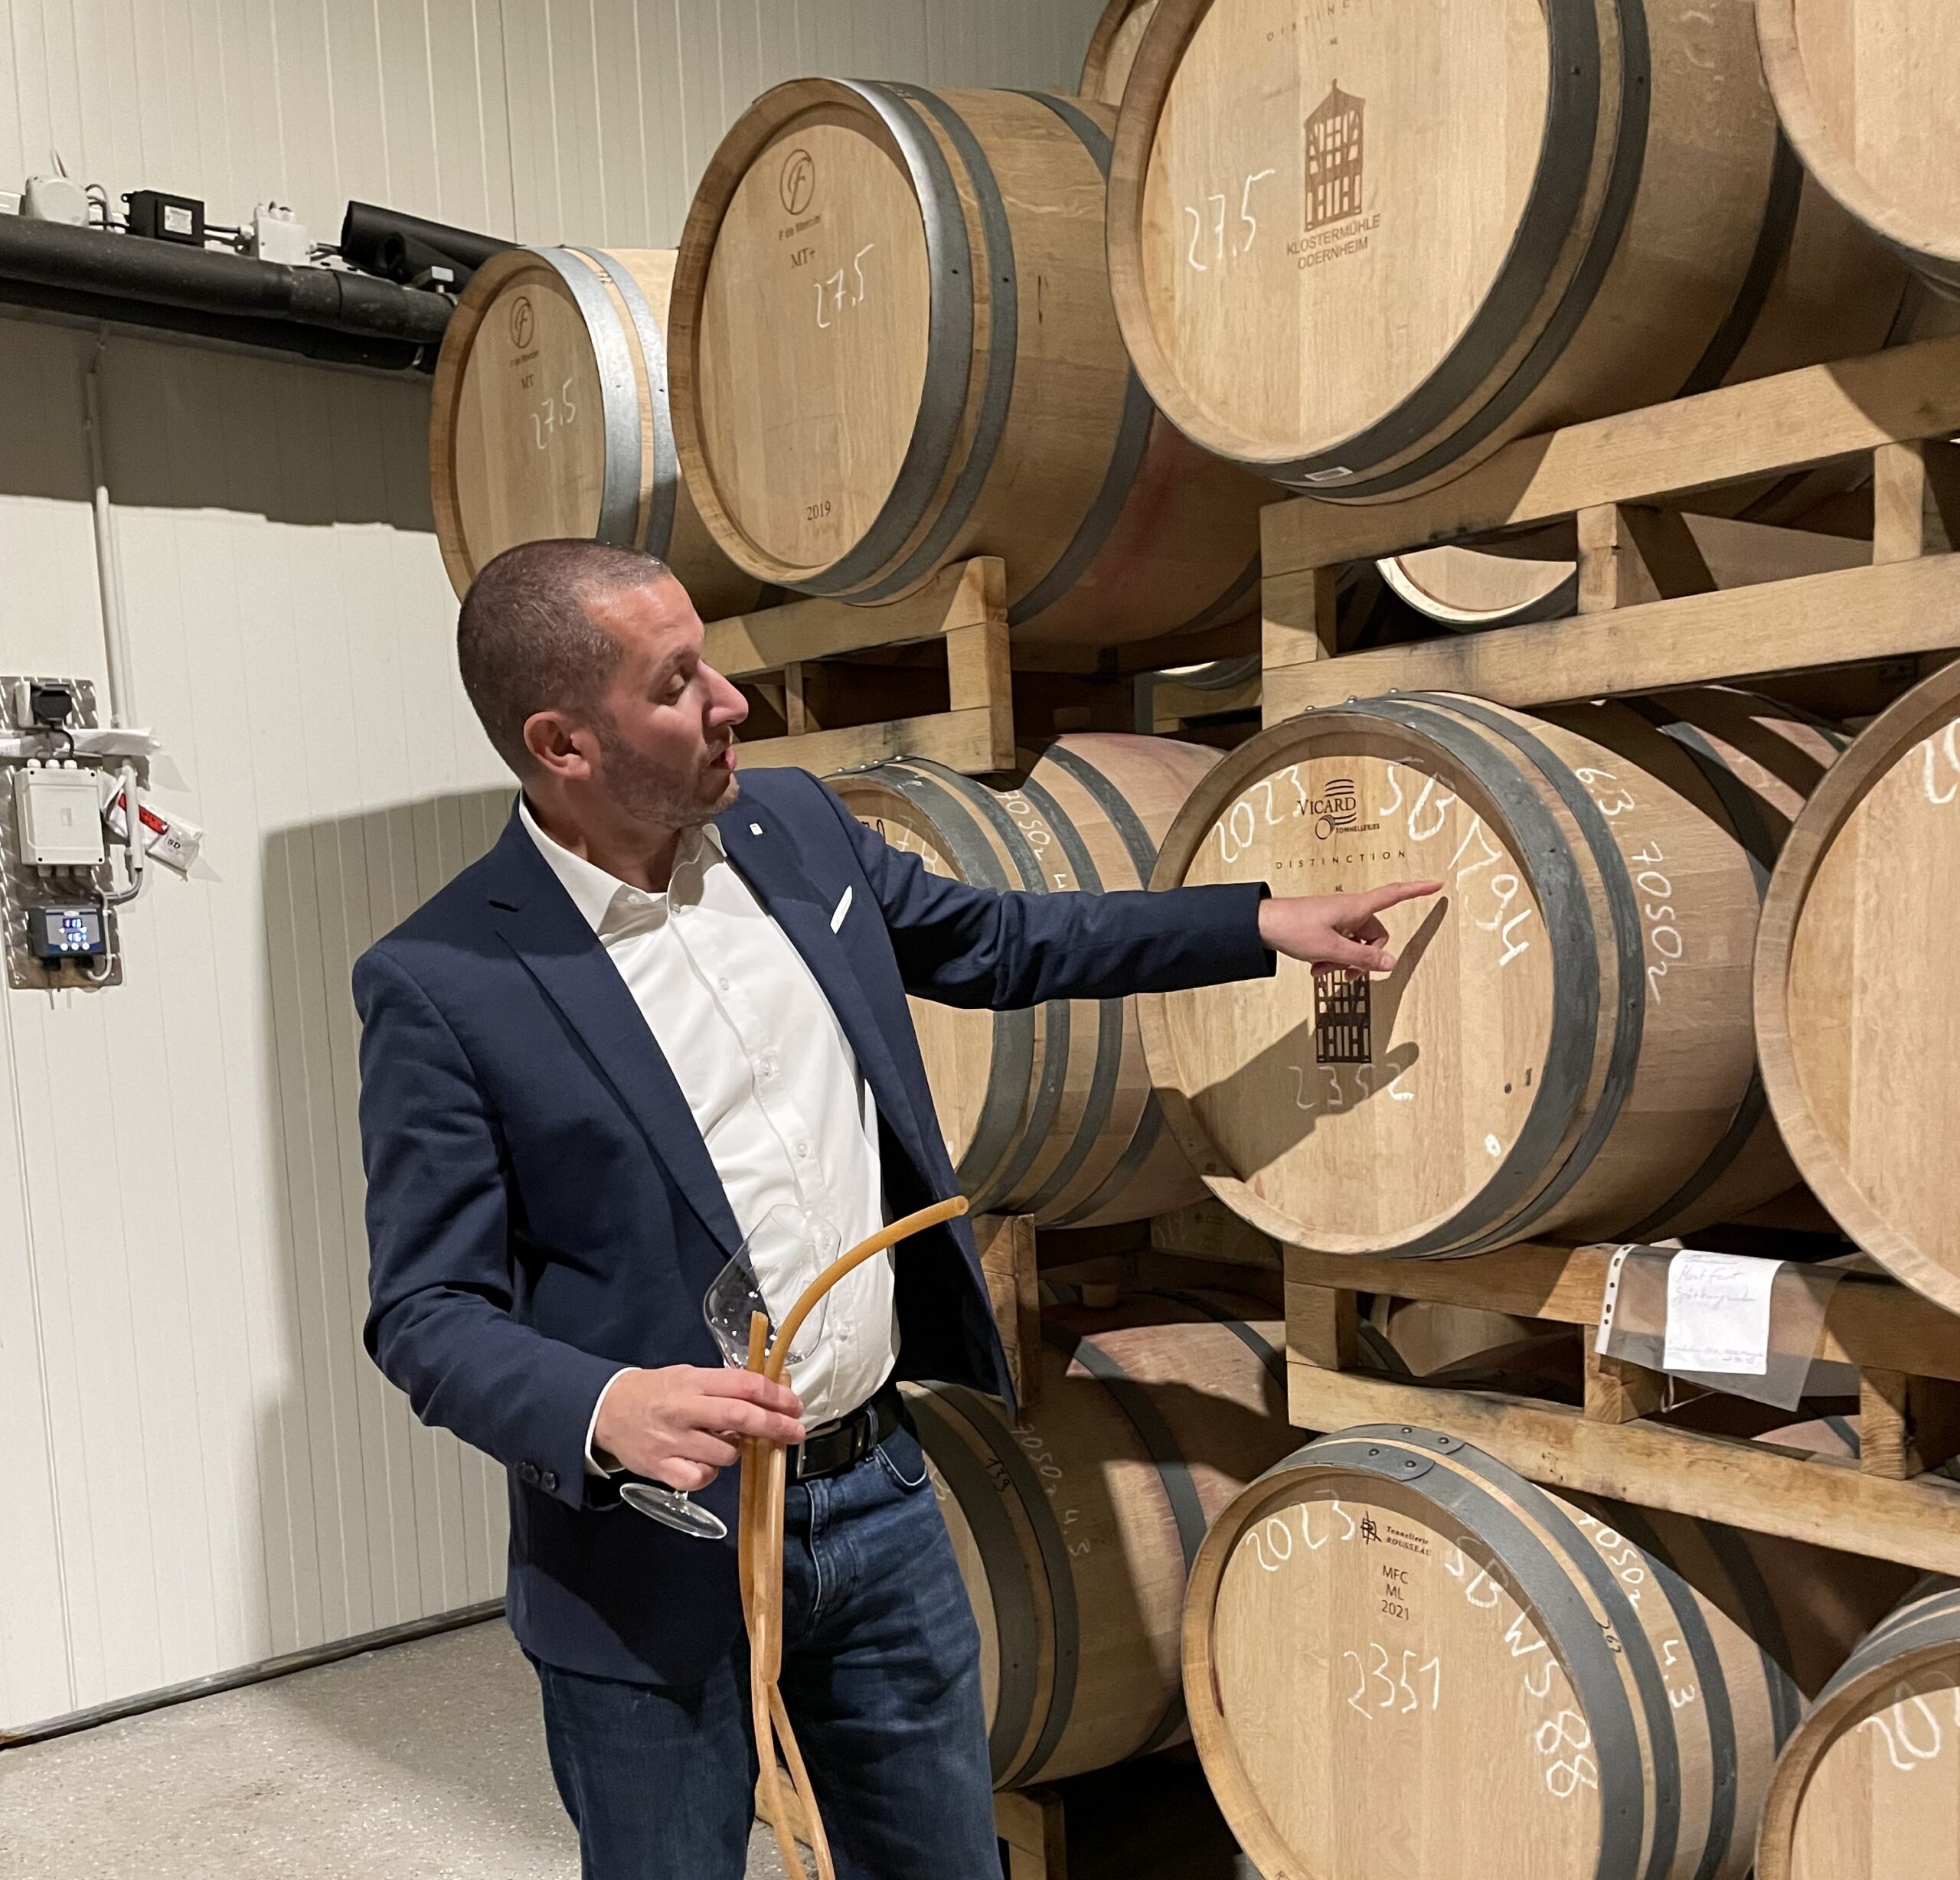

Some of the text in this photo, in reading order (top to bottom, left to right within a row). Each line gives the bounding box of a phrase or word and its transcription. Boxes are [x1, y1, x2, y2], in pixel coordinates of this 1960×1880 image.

[1287, 214, 1380, 256] KLOSTERMÜHLE
[1298, 236, 1368, 269] ODERNHEIM
[806, 501, 831, 521] 2019
[1210, 765, 1307, 863] 2023
[1297, 797, 1357, 816] VICARD
[1335, 823, 1380, 834] TONNELLERIES
[1276, 850, 1406, 870] DISTINCTION
[1288, 1063, 1416, 1110] 2352
[1246, 1489, 1356, 1572] 2023
[1387, 1536, 1431, 1556] ROUSSEAU
[1383, 1565, 1409, 1584] MFC
[1387, 1583, 1405, 1601] ML
[1381, 1599, 1410, 1621] 2021
[1344, 1643, 1440, 1719] 2351
